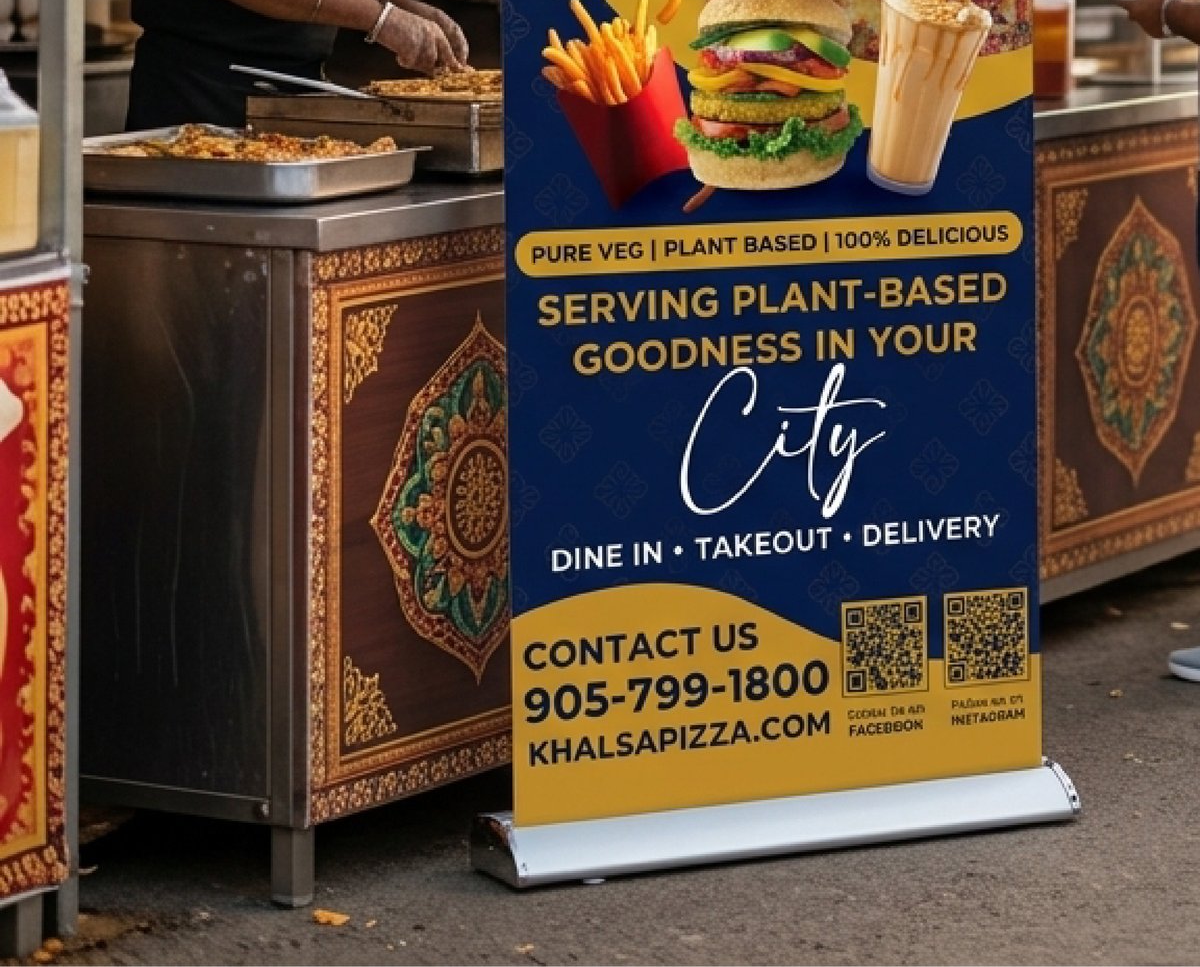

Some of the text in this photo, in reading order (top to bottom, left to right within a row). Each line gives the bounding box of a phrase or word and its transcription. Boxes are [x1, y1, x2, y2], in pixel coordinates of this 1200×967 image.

[530, 244, 592, 264] PURE
[597, 241, 644, 261] VEG
[663, 237, 738, 257] PLANT
[743, 233, 818, 254] BASED
[834, 230, 891, 251] 100%
[897, 224, 1010, 248] DELICIOUS
[537, 272, 1007, 327] SERVING PLANT-BASED
[572, 321, 977, 376] GOODNESS IN YOUR
[679, 362, 887, 519] City
[550, 513, 1000, 573] DINE IN TAKEOUT DELIVERY
[522, 621, 760, 671] CONTACT US
[523, 658, 830, 724] 905-799-1800
[529, 711, 831, 767] KHALSAPIZZA.COM
